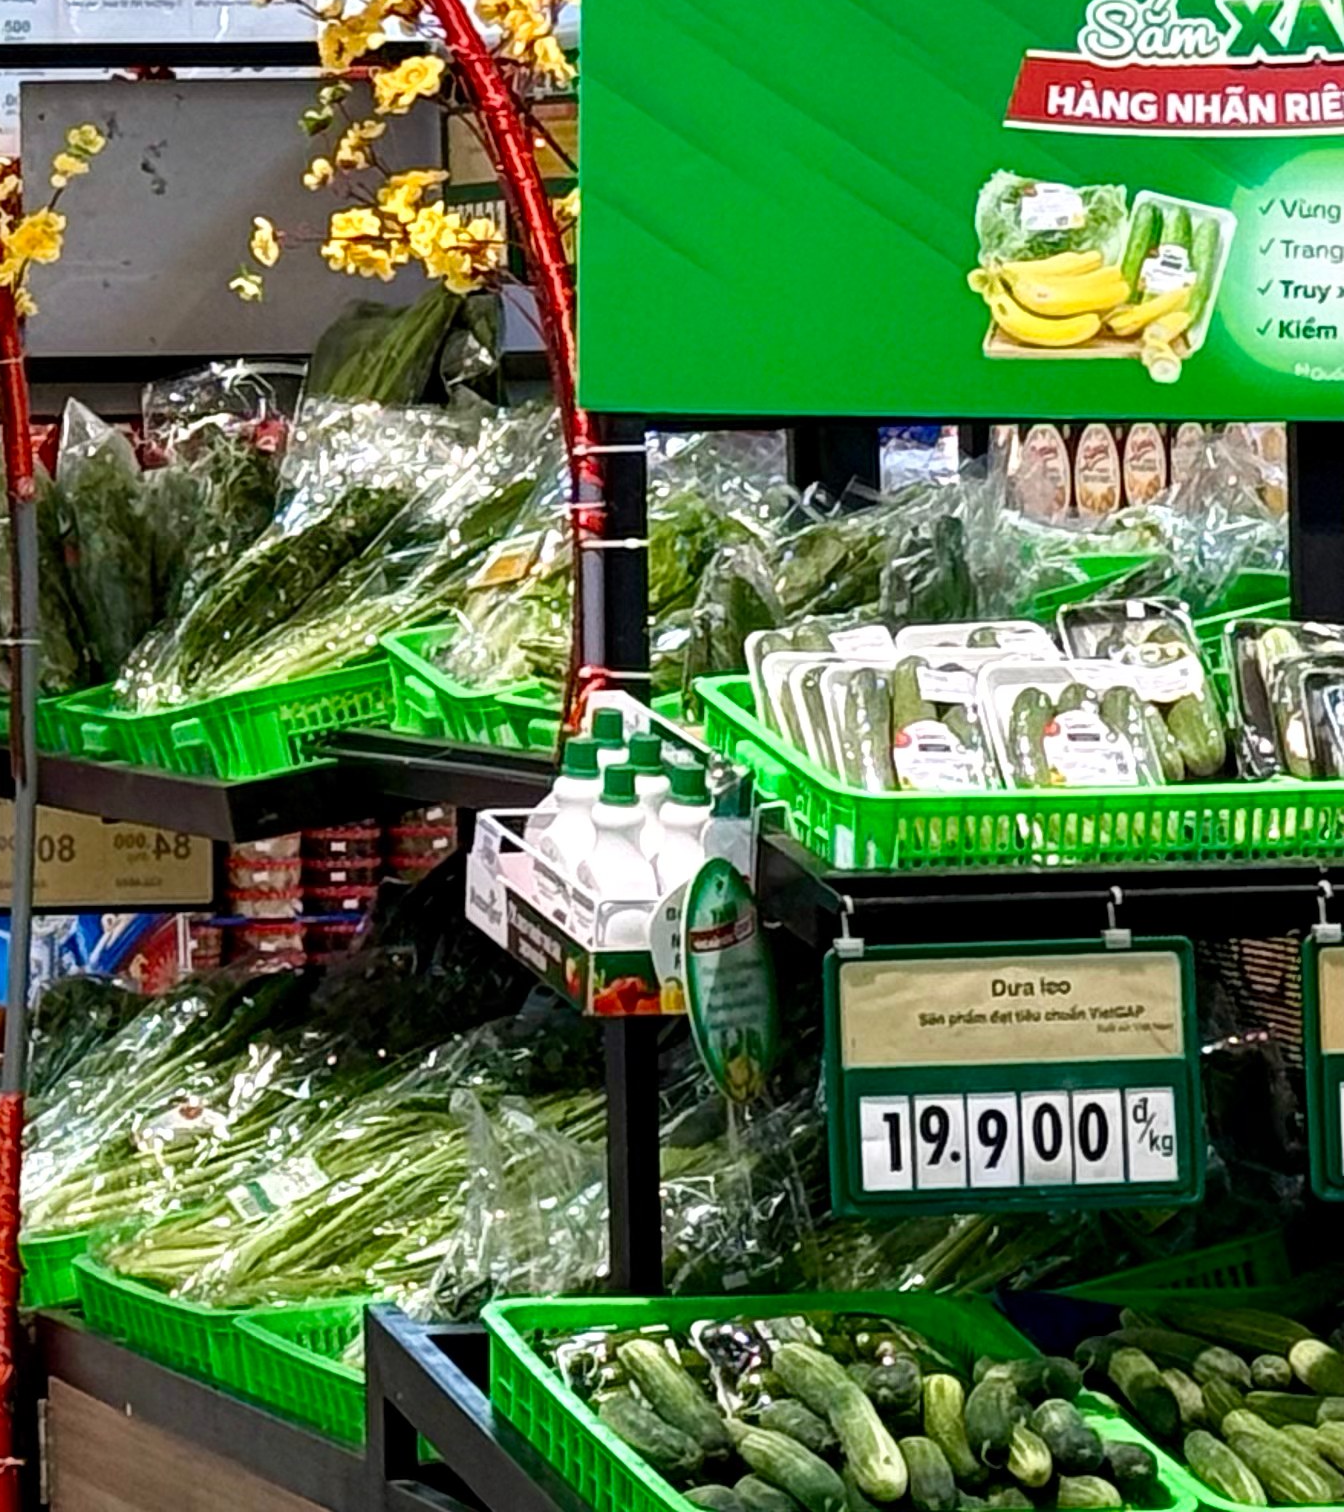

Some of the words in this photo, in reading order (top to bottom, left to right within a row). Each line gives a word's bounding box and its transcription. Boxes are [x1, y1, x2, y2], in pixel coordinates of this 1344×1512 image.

[1048, 82, 1157, 120] HÀNG
[1167, 88, 1276, 124] NHÃN
[1280, 198, 1341, 224] Vùng
[1280, 280, 1332, 304] Truy
[991, 978, 1036, 998] Dưa
[1040, 978, 1073, 997] leo
[883, 1102, 1110, 1172] 19.900
